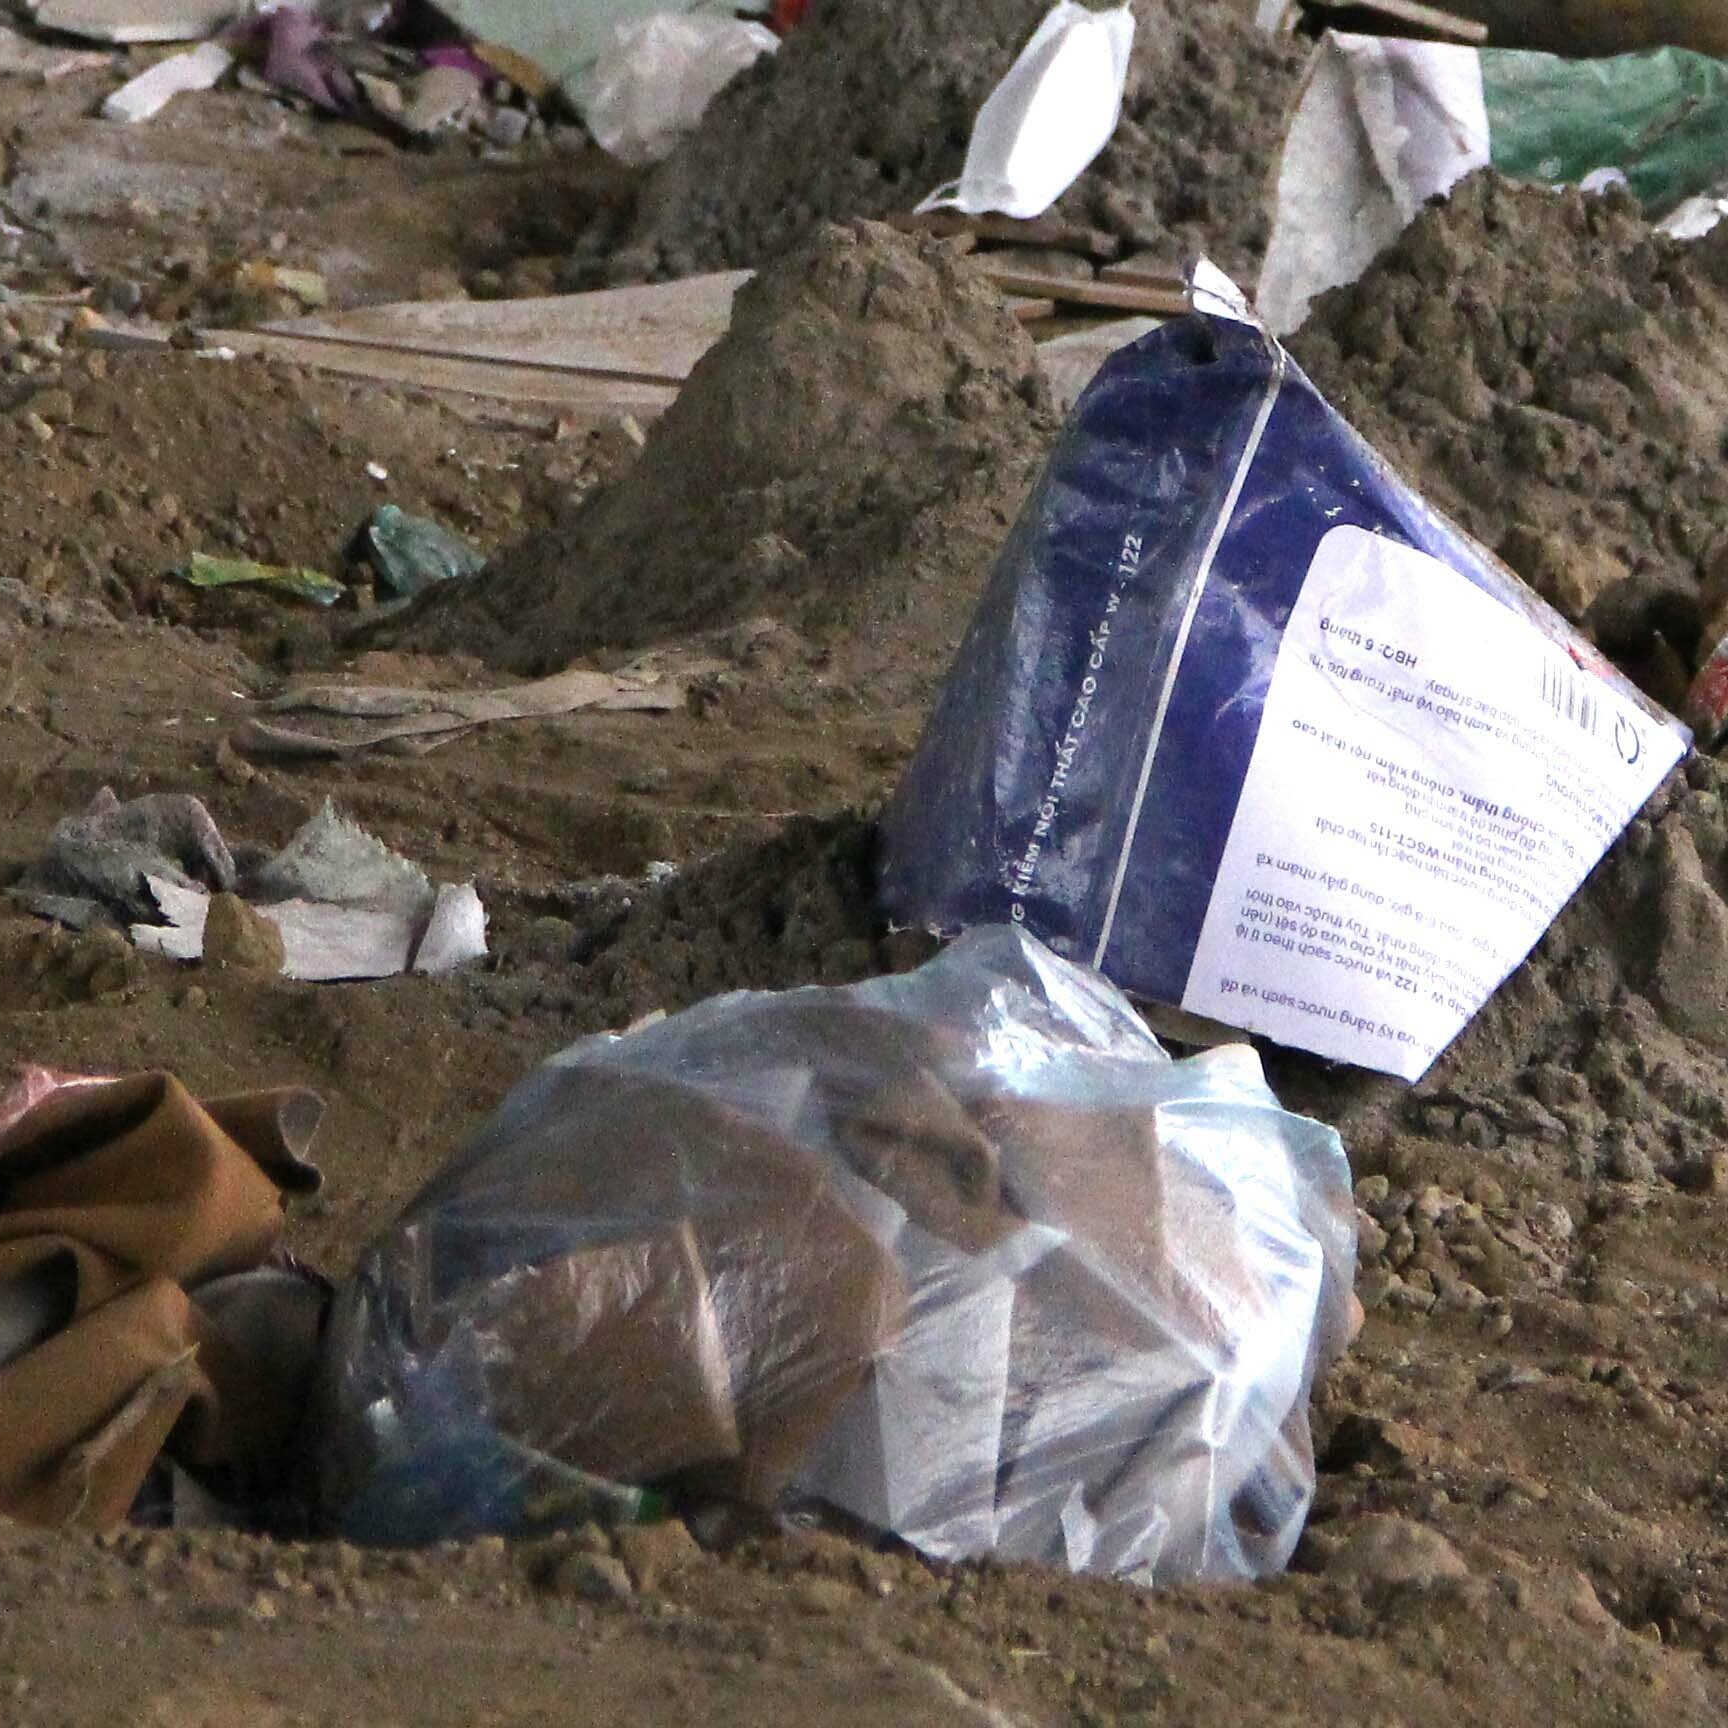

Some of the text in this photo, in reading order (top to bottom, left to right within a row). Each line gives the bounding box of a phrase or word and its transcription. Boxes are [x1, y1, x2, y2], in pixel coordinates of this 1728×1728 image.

[1114, 532, 1147, 577] 122
[1317, 615, 1363, 647] tháng
[1078, 616, 1116, 671] CẤP
[1068, 674, 1100, 729] CAO
[1413, 694, 1434, 714] vệ
[1433, 704, 1462, 726] bảo
[1290, 718, 1318, 737] cao
[1042, 730, 1080, 790] THẤT
[1407, 768, 1456, 803] chống
[1029, 791, 1062, 839] NỘI
[1498, 806, 1546, 840] chống
[1366, 821, 1441, 861] WSCT-115
[1242, 888, 1274, 909] thời
[1273, 898, 1302, 917] vào
[1237, 902, 1274, 927] (nên
[1271, 914, 1299, 935] sệt
[1301, 904, 1344, 931] thuộc
[1233, 921, 1250, 939] lệ
[1296, 921, 1319, 941] độ
[1319, 931, 1347, 947] vừa
[1260, 932, 1295, 953] theo
[1295, 940, 1333, 964] sạch
[1347, 941, 1376, 961] cho
[1331, 954, 1372, 979] nước
[1373, 968, 1392, 986] và
[1238, 983, 1258, 1000] và
[1392, 975, 1418, 996] 122
[1258, 987, 1297, 1010] sạch
[1294, 1000, 1337, 1023] nước
